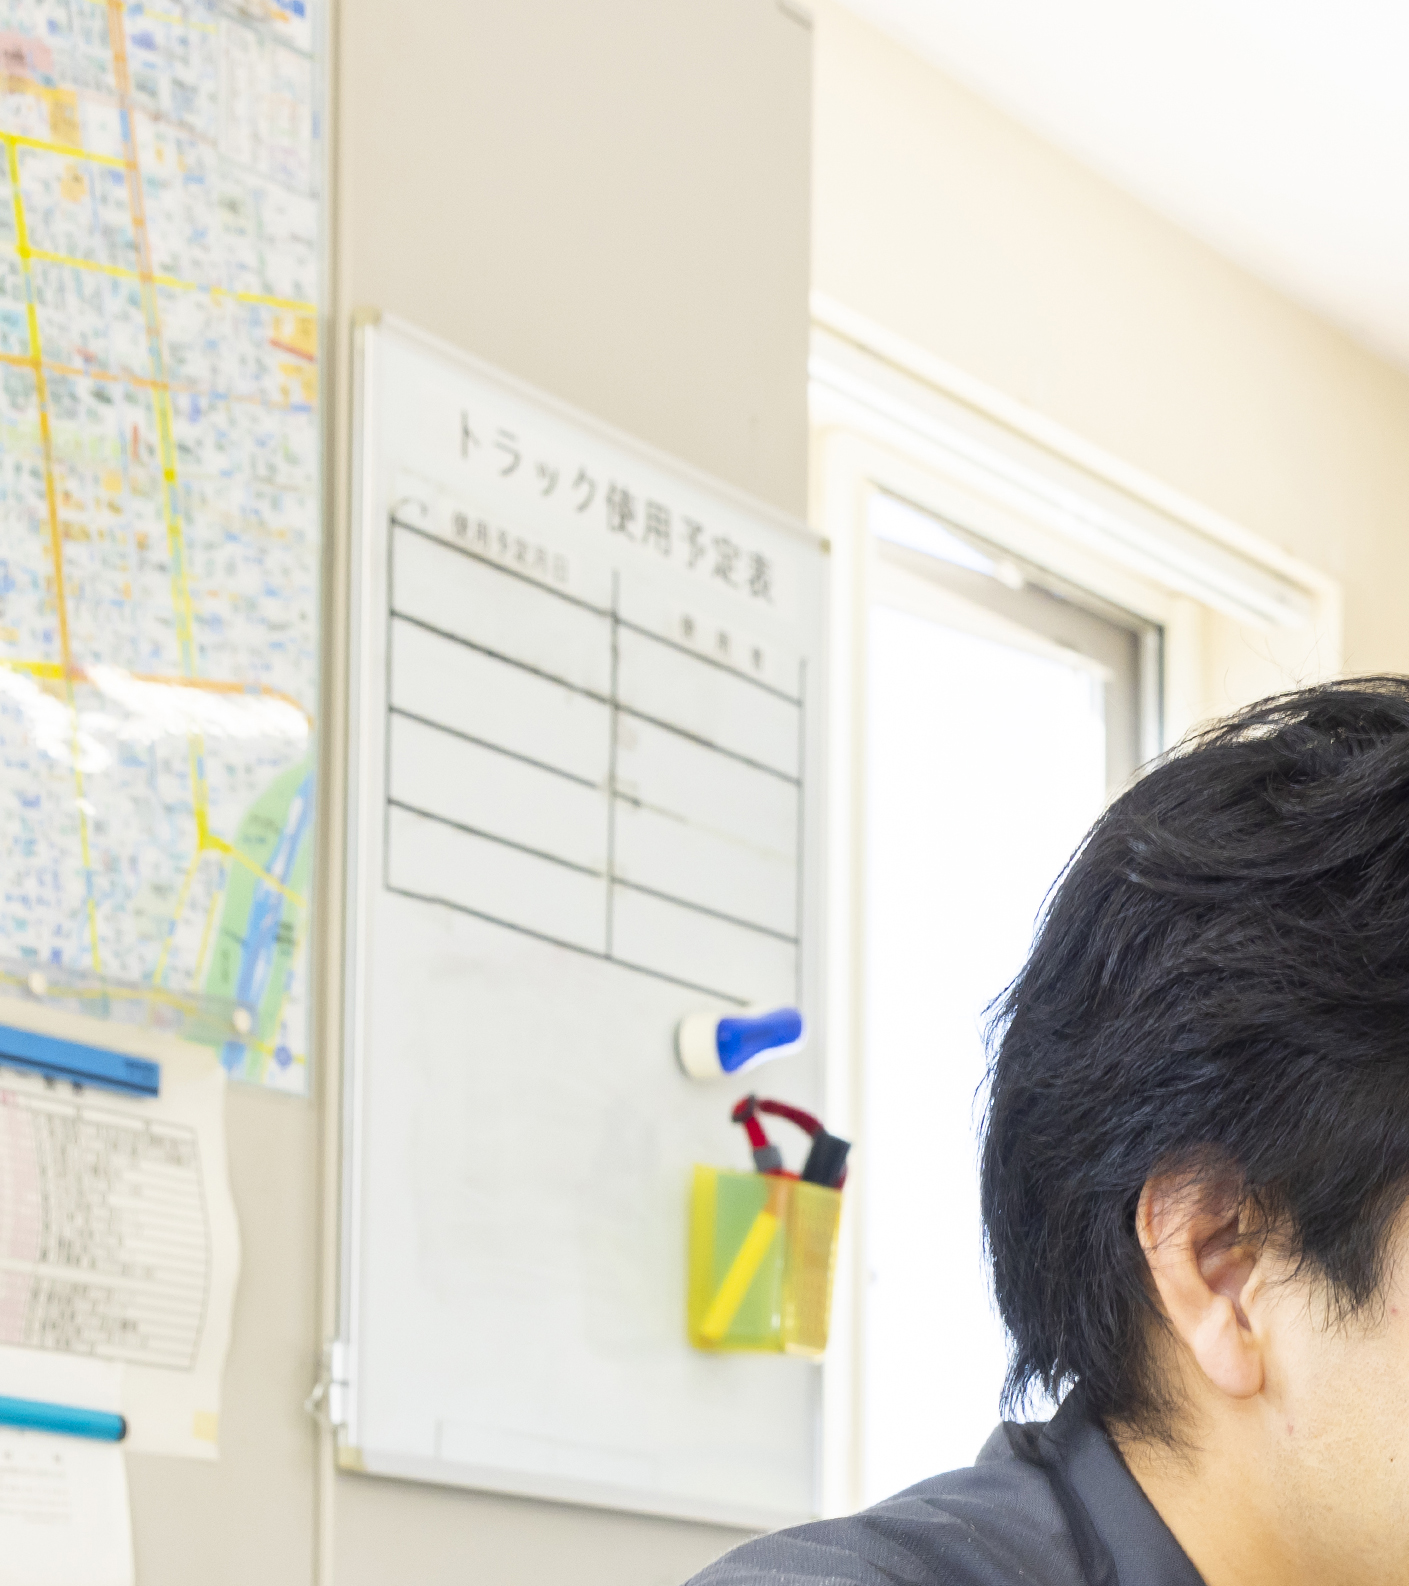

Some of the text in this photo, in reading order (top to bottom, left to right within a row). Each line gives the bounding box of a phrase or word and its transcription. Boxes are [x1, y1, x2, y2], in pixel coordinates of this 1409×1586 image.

[458, 408, 776, 606] トラック使用予定表
